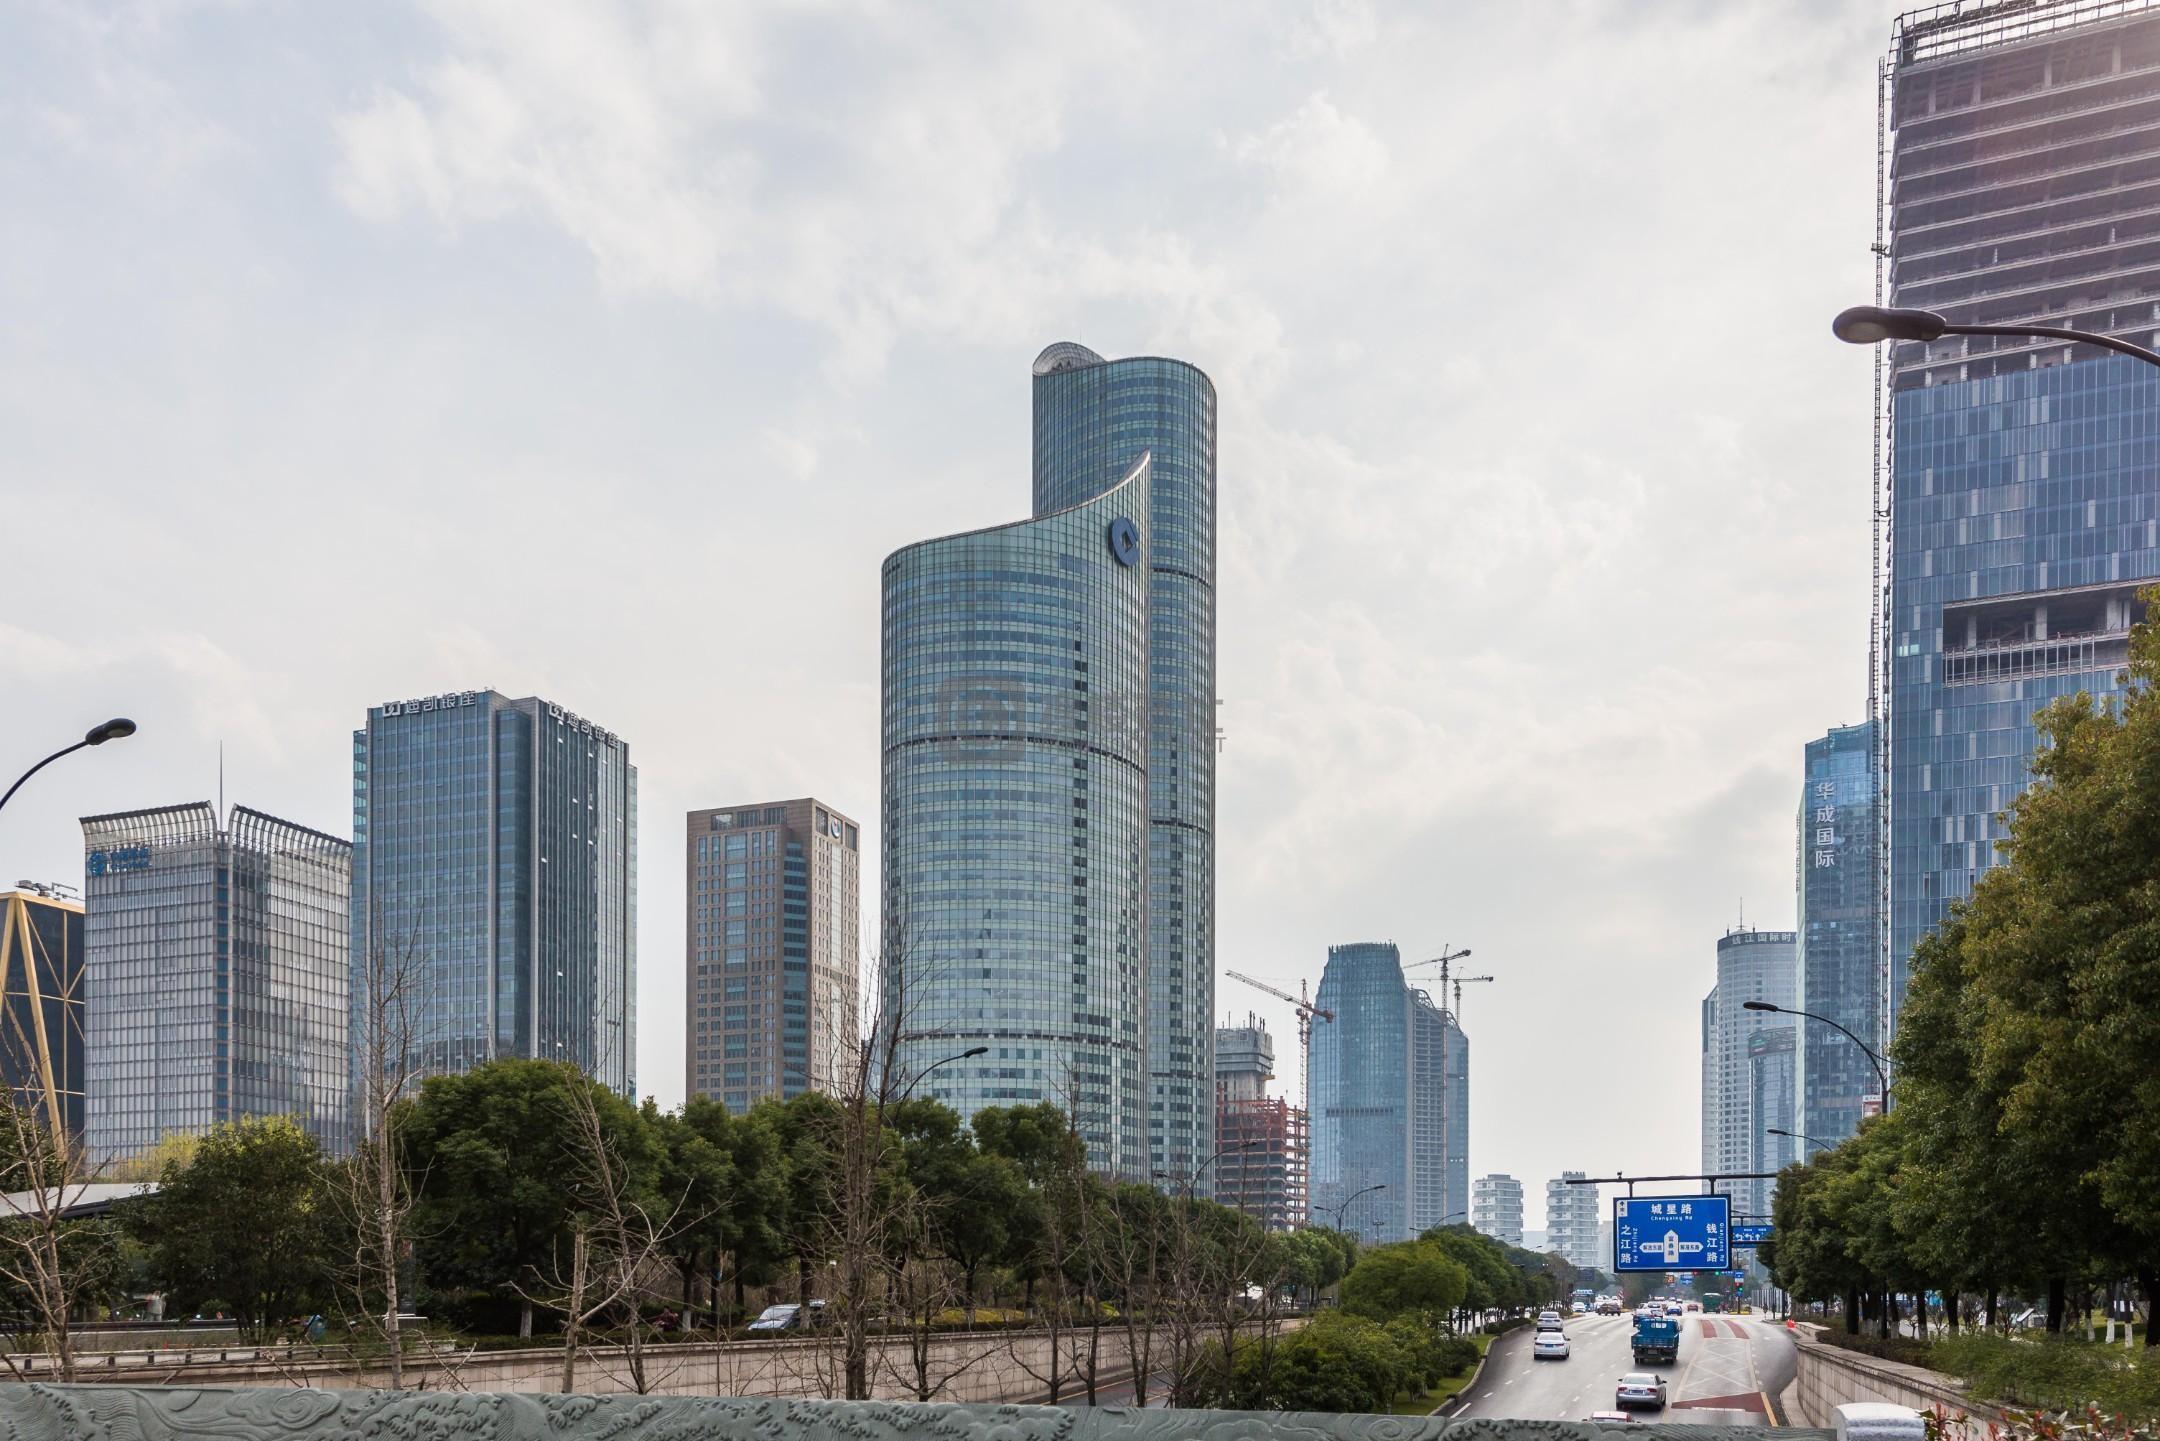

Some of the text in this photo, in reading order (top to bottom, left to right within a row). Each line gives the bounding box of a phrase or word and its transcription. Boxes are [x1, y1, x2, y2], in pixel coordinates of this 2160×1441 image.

[405, 691, 475, 713] 迪凯银座
[1815, 782, 1835, 868] 华成国际
[1732, 932, 1797, 944] 钱江国际时
[1651, 1203, 1692, 1214] 城星路
[1620, 1225, 1631, 1263] 之江路
[1706, 1223, 1717, 1262] 钱江路
